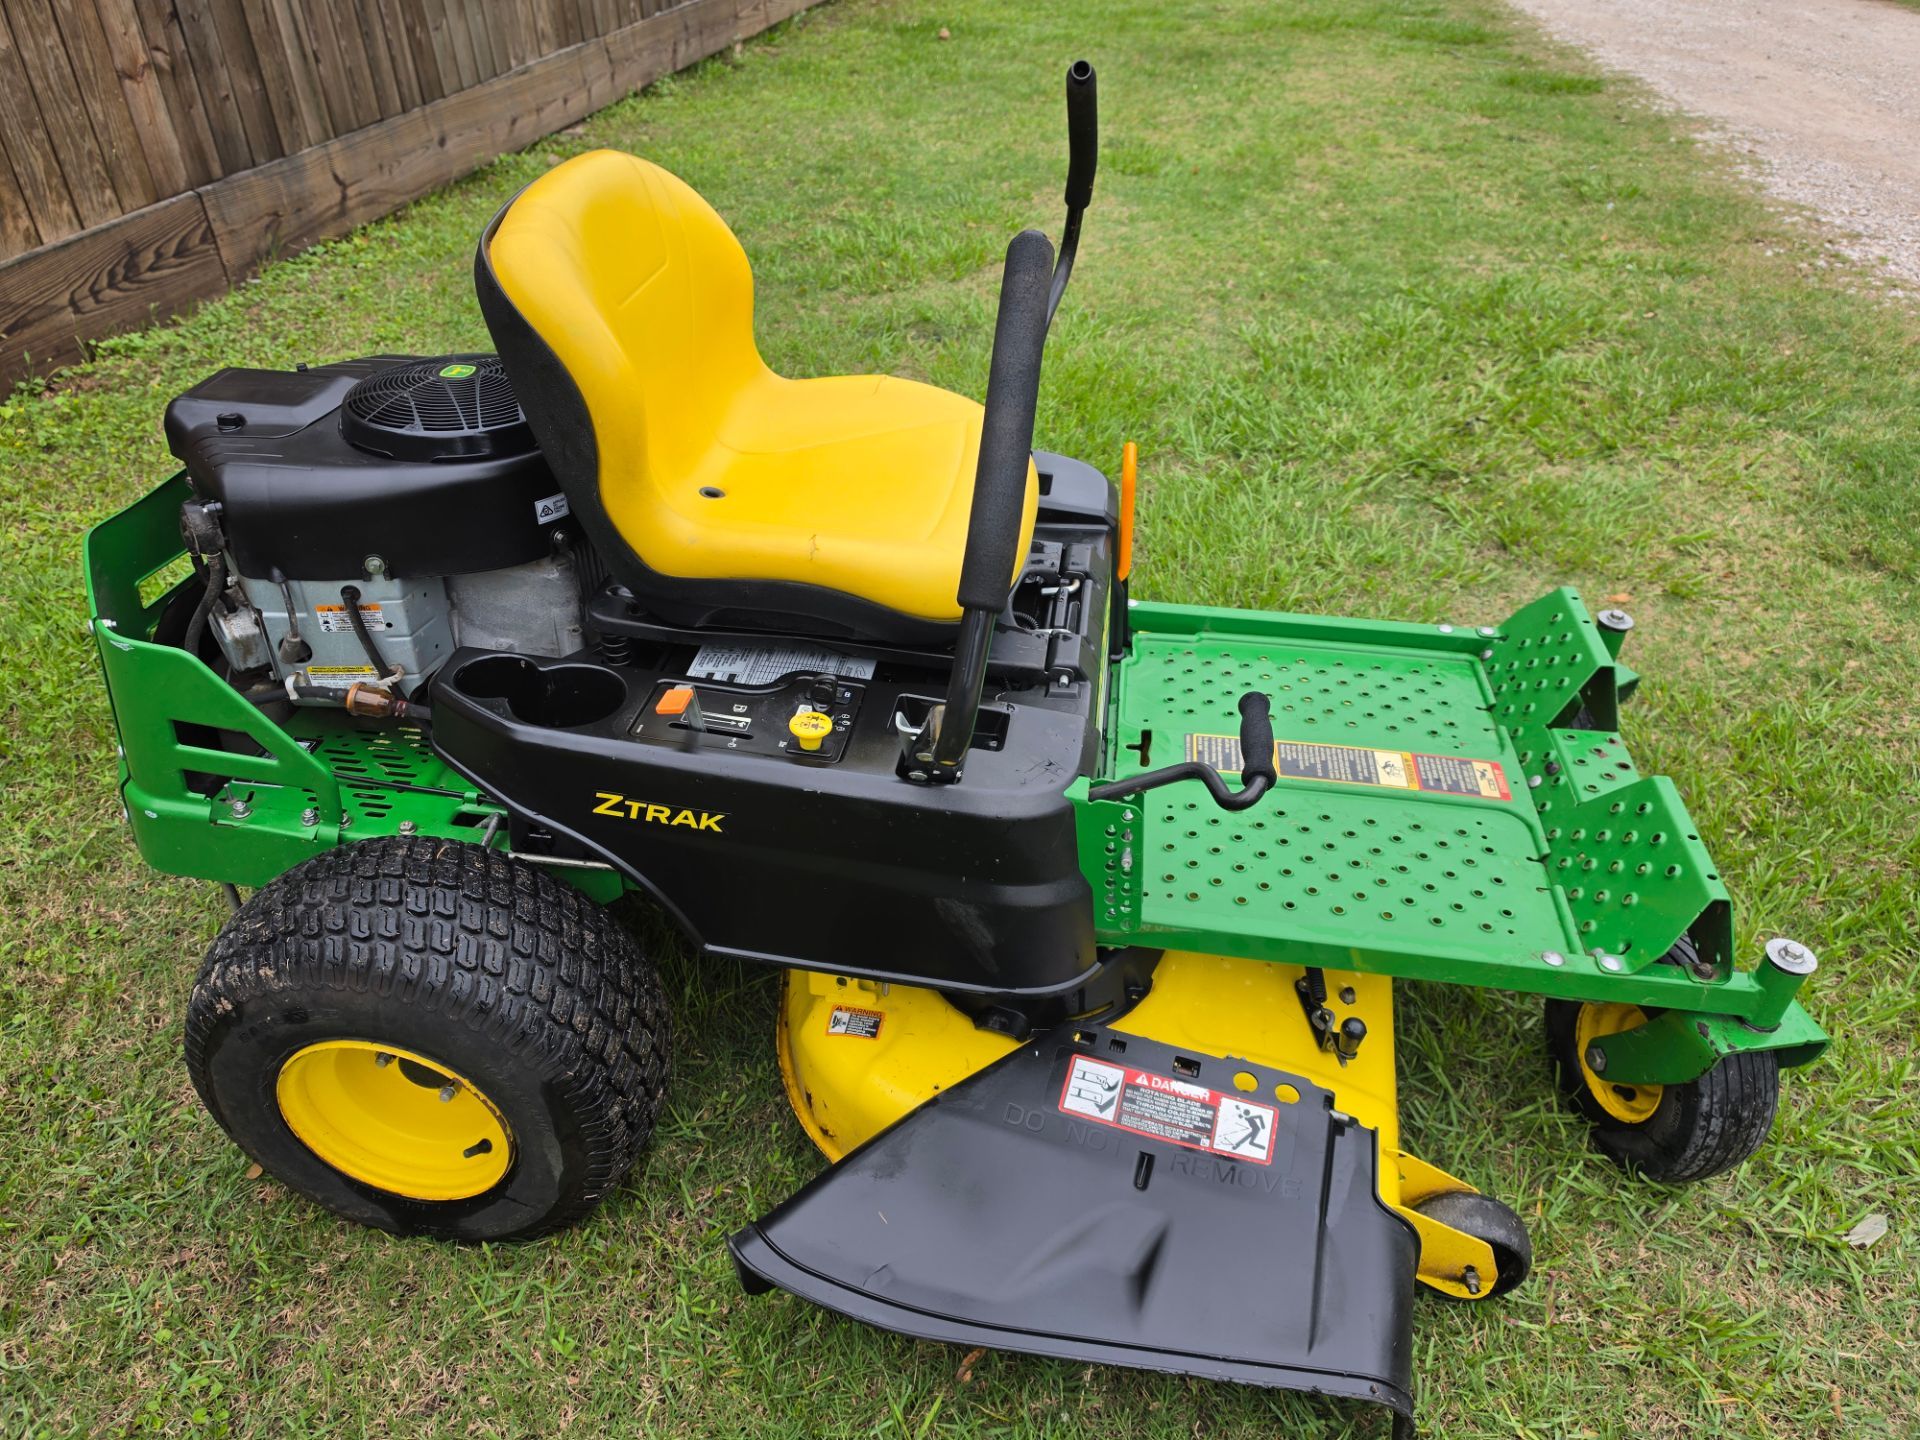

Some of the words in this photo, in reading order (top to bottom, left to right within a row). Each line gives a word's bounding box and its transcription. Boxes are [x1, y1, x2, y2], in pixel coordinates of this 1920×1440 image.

[592, 792, 725, 832] ZTRAK
[845, 1006, 882, 1017] WARNING
[1140, 1087, 1176, 1101] ROTATING
[1176, 1097, 1201, 1108] BLADE
[1135, 1100, 1166, 1113] THROWN
[1167, 1109, 1200, 1122] OBJECTS
[1002, 1102, 1046, 1132] DO
[1065, 1121, 1129, 1156] NOT
[1170, 1154, 1303, 1200] REMOVE
